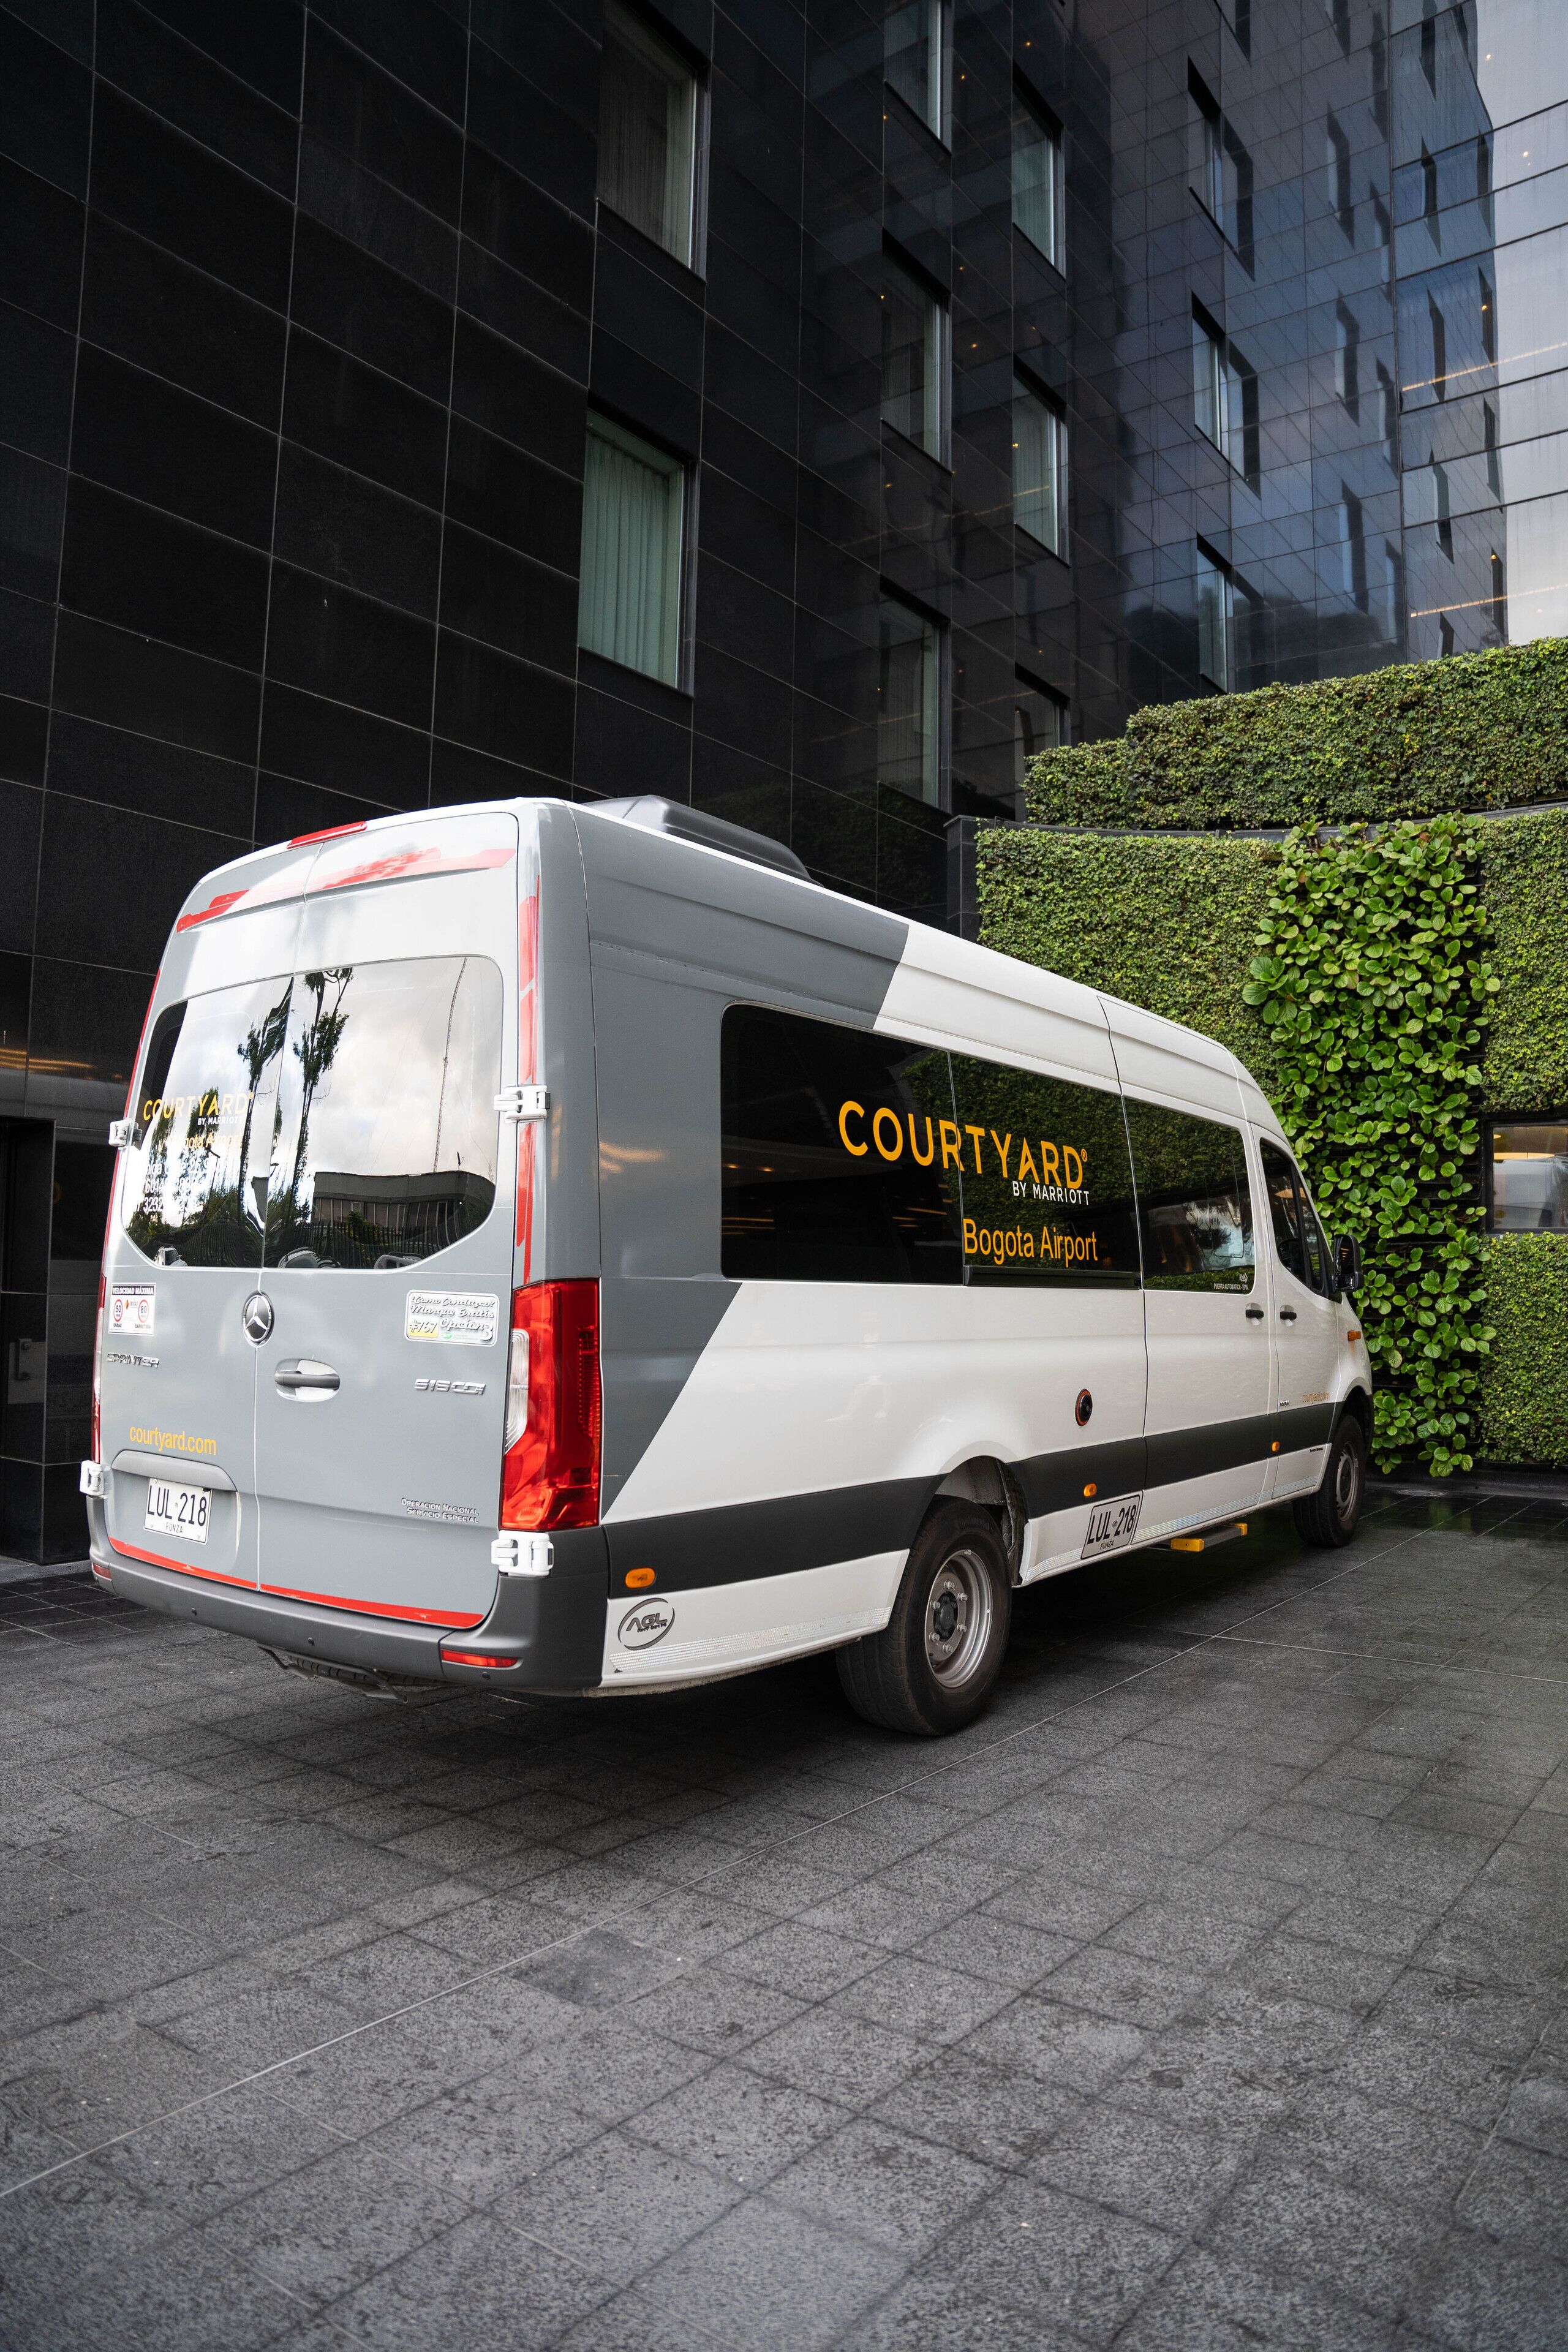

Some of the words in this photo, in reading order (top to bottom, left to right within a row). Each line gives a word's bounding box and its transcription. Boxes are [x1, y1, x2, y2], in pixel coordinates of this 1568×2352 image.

[197, 1117, 206, 1126] BY
[1012, 1181, 1027, 1198] BY
[1032, 1184, 1089, 1206] MARRIOTT
[963, 1218, 1035, 1265] Bogota
[1041, 1226, 1098, 1268] Airport
[411, 1305, 456, 1317] Marque
[410, 1319, 437, 1333] #767
[480, 1323, 494, 1341] 3
[107, 1352, 159, 1368] SPRINTER
[1302, 1392, 1330, 1404] courtyard.com
[130, 1427, 217, 1455] courtyard.com
[148, 1485, 172, 1520] LUL
[178, 1493, 207, 1526] 218
[401, 1498, 441, 1510] OPERACION
[442, 1503, 479, 1516] NACIONAL
[407, 1507, 440, 1518] SERVICIO
[442, 1512, 479, 1523] ESPECIAL
[166, 1522, 183, 1534] FUNZA
[1087, 1511, 1111, 1545] LUL
[1114, 1504, 1136, 1537] 218
[1099, 1540, 1114, 1550] FUNZA
[626, 1613, 668, 1632] AGL
